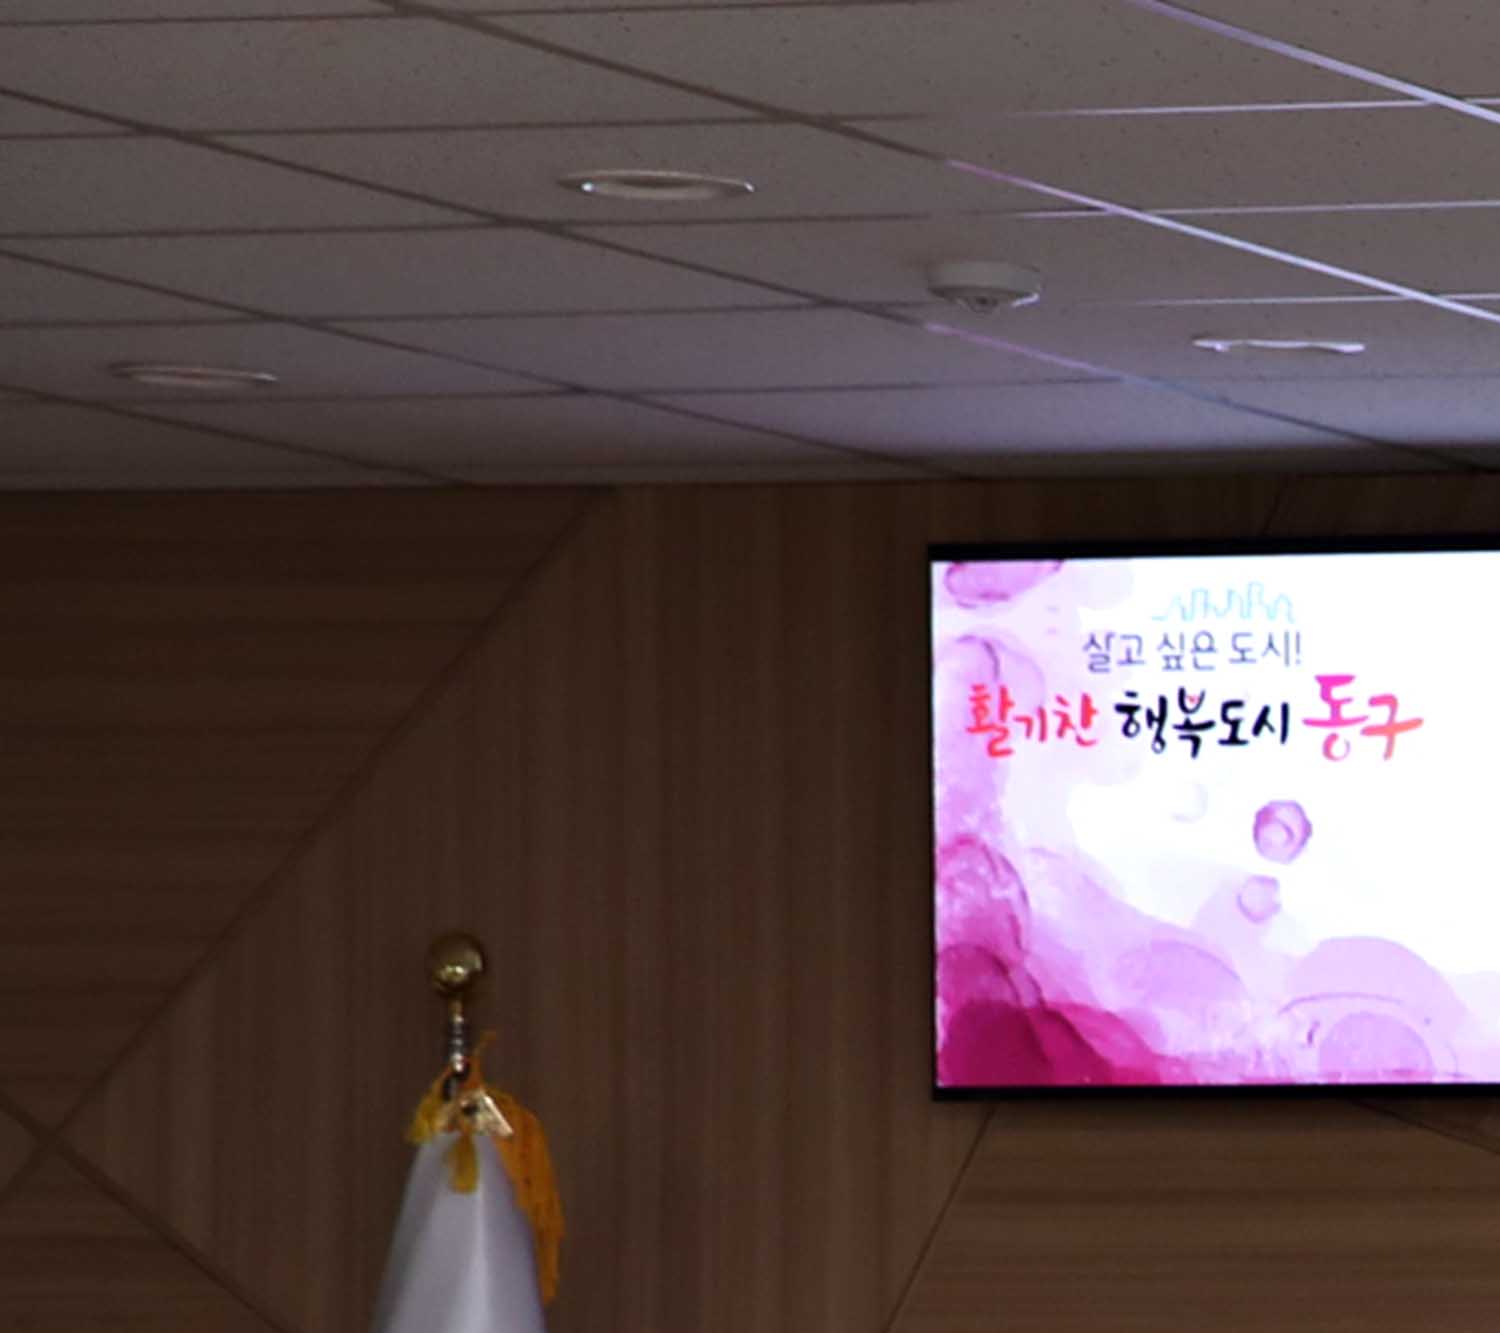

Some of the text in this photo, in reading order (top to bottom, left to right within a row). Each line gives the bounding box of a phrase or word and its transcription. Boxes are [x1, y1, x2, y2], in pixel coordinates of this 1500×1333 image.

[1082, 631, 1302, 674] 살고 싶은 도시!
[965, 674, 1425, 762] 활기찬 행복도시 동구
